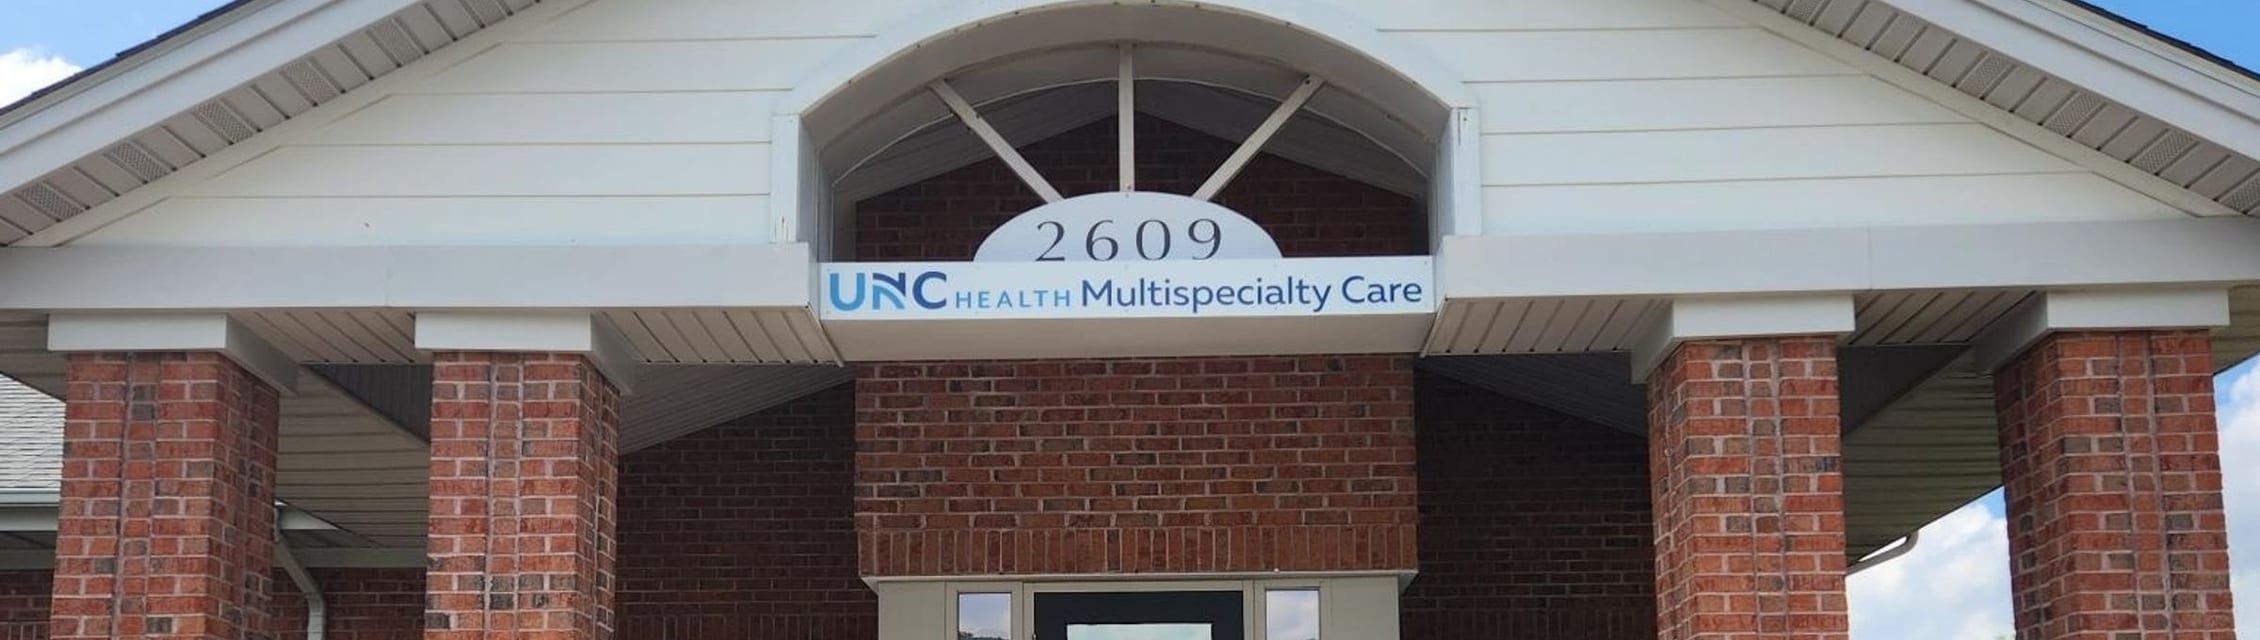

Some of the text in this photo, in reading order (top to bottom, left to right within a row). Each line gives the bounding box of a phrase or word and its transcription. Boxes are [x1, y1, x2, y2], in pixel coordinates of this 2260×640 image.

[1035, 218, 1222, 262] 2609
[829, 271, 1423, 313] UNC HEALTH Multispecialty Care
